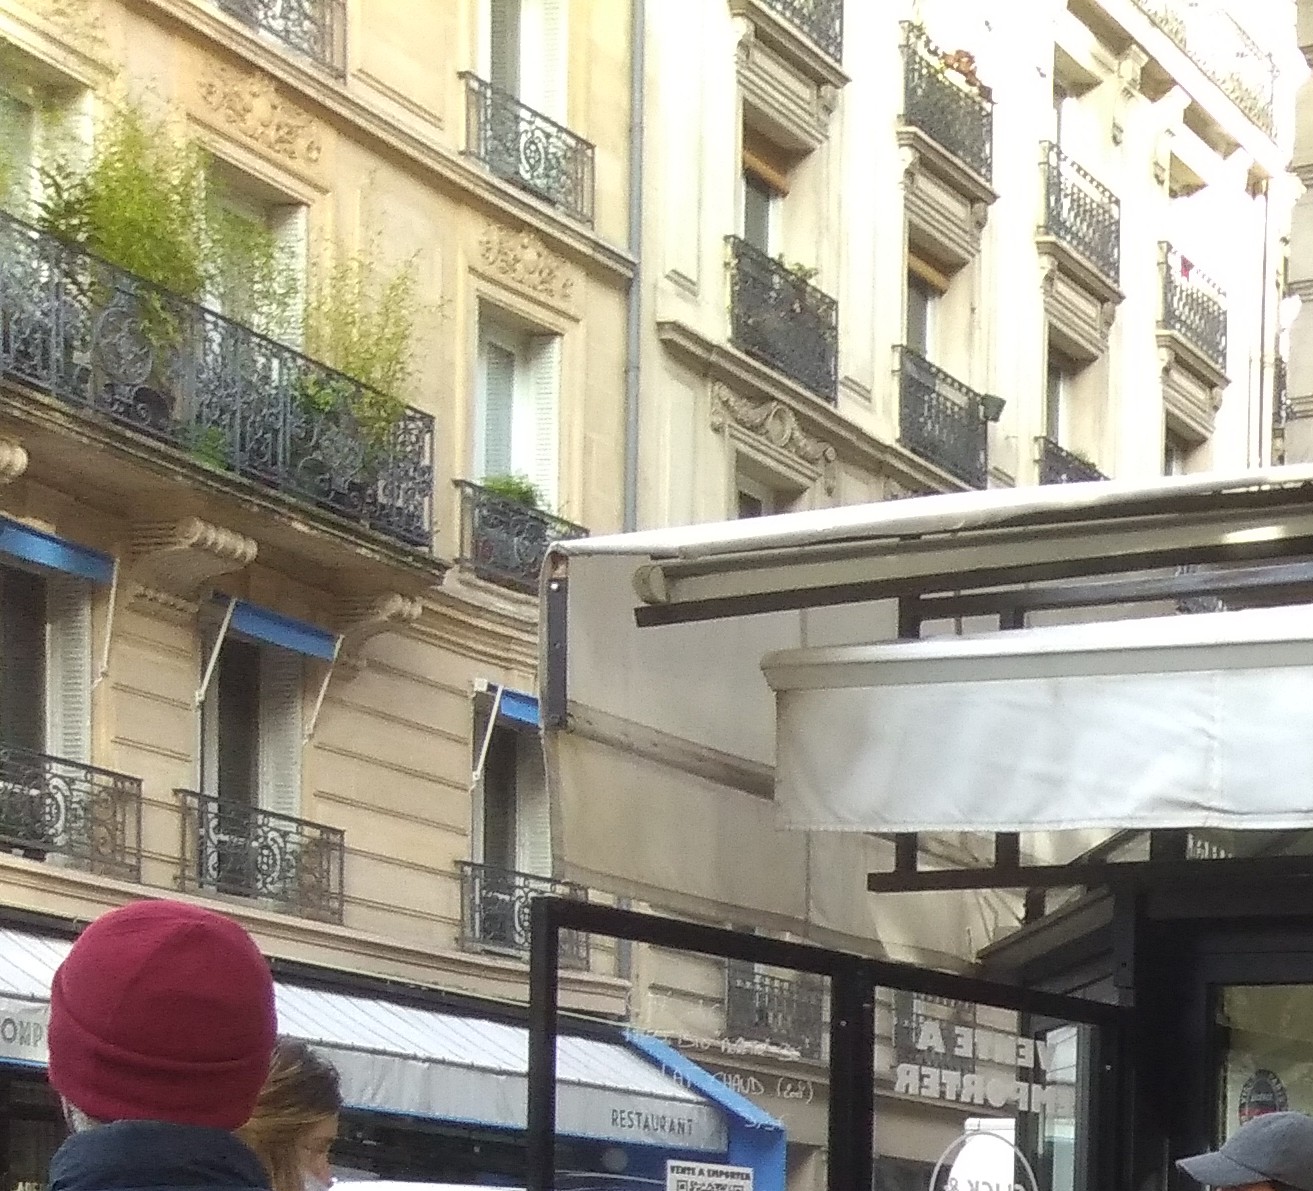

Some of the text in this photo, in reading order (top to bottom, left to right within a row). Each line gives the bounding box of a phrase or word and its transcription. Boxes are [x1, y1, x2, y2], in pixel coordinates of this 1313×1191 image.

[611, 1108, 693, 1136] RESTAURANT
[670, 1164, 751, 1181] VENTE A EMPORTER
